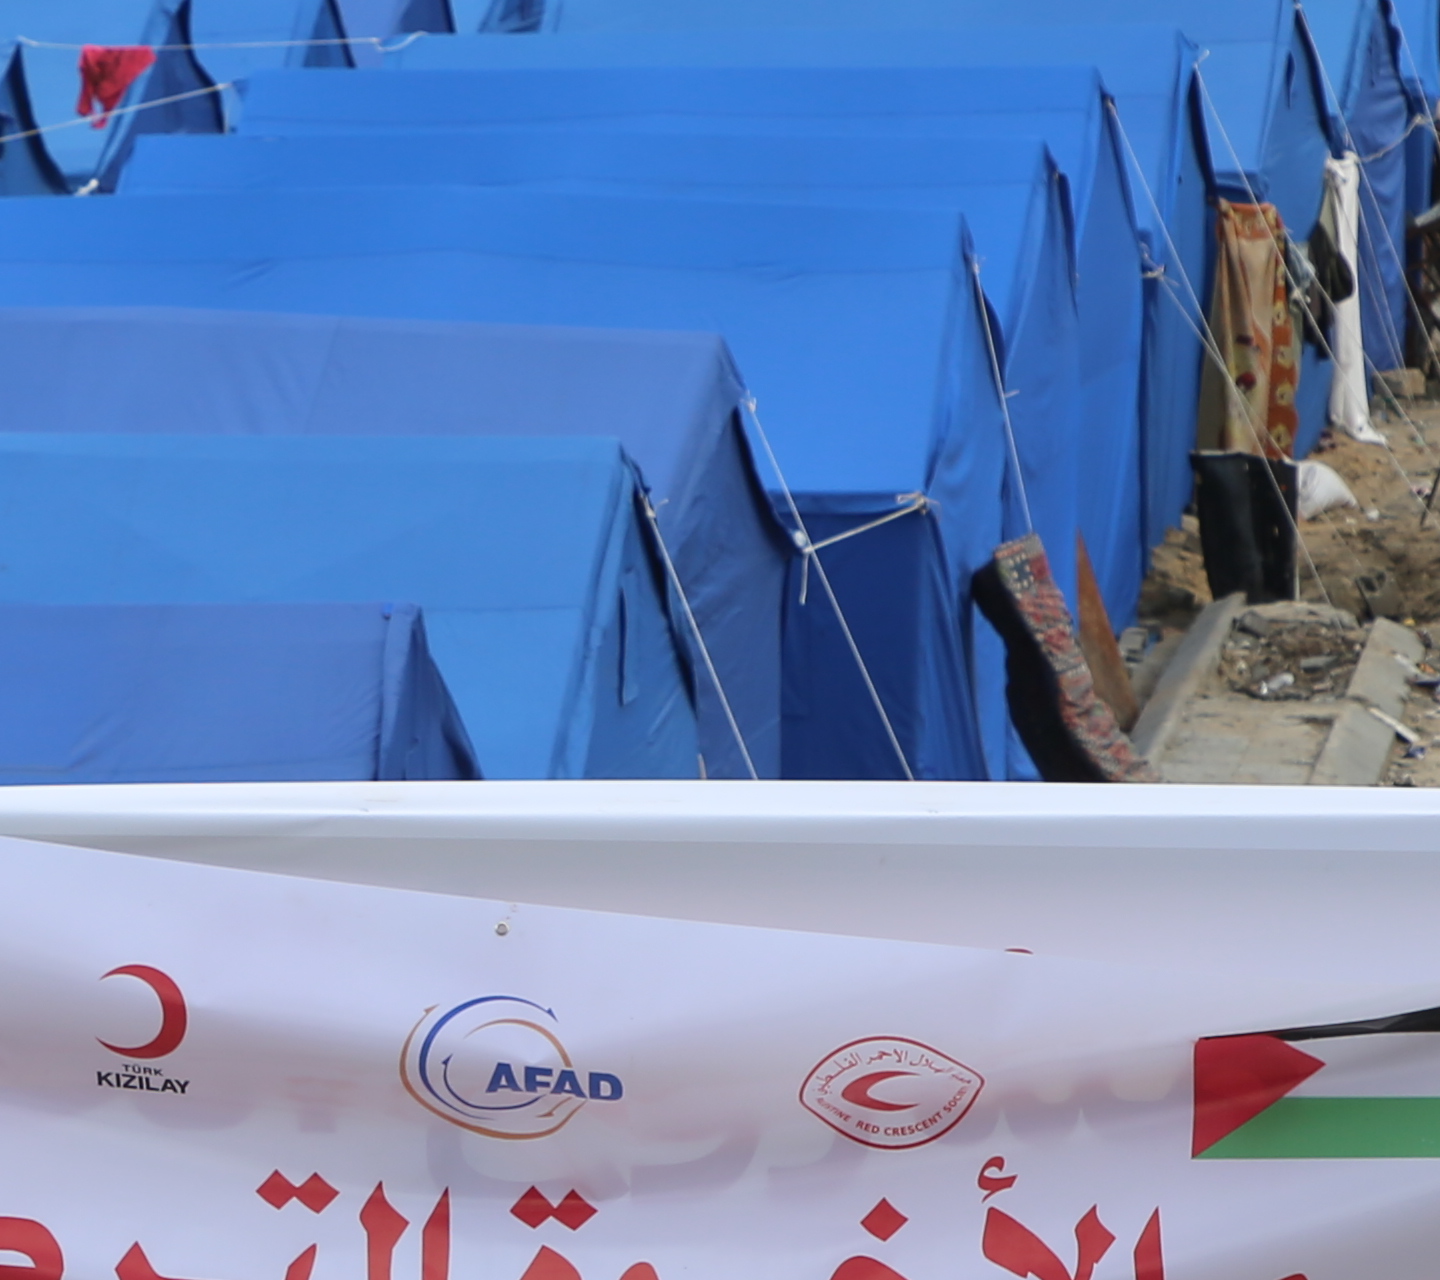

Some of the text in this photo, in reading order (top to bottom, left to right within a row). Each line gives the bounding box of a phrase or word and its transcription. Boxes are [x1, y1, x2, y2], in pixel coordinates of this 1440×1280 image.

[123, 1064, 163, 1076] TÜRK
[485, 1061, 623, 1101] AFAD
[97, 1072, 189, 1094] KIZILAY
[856, 1119, 881, 1136] RED
[884, 1112, 944, 1137] CRESCENT
